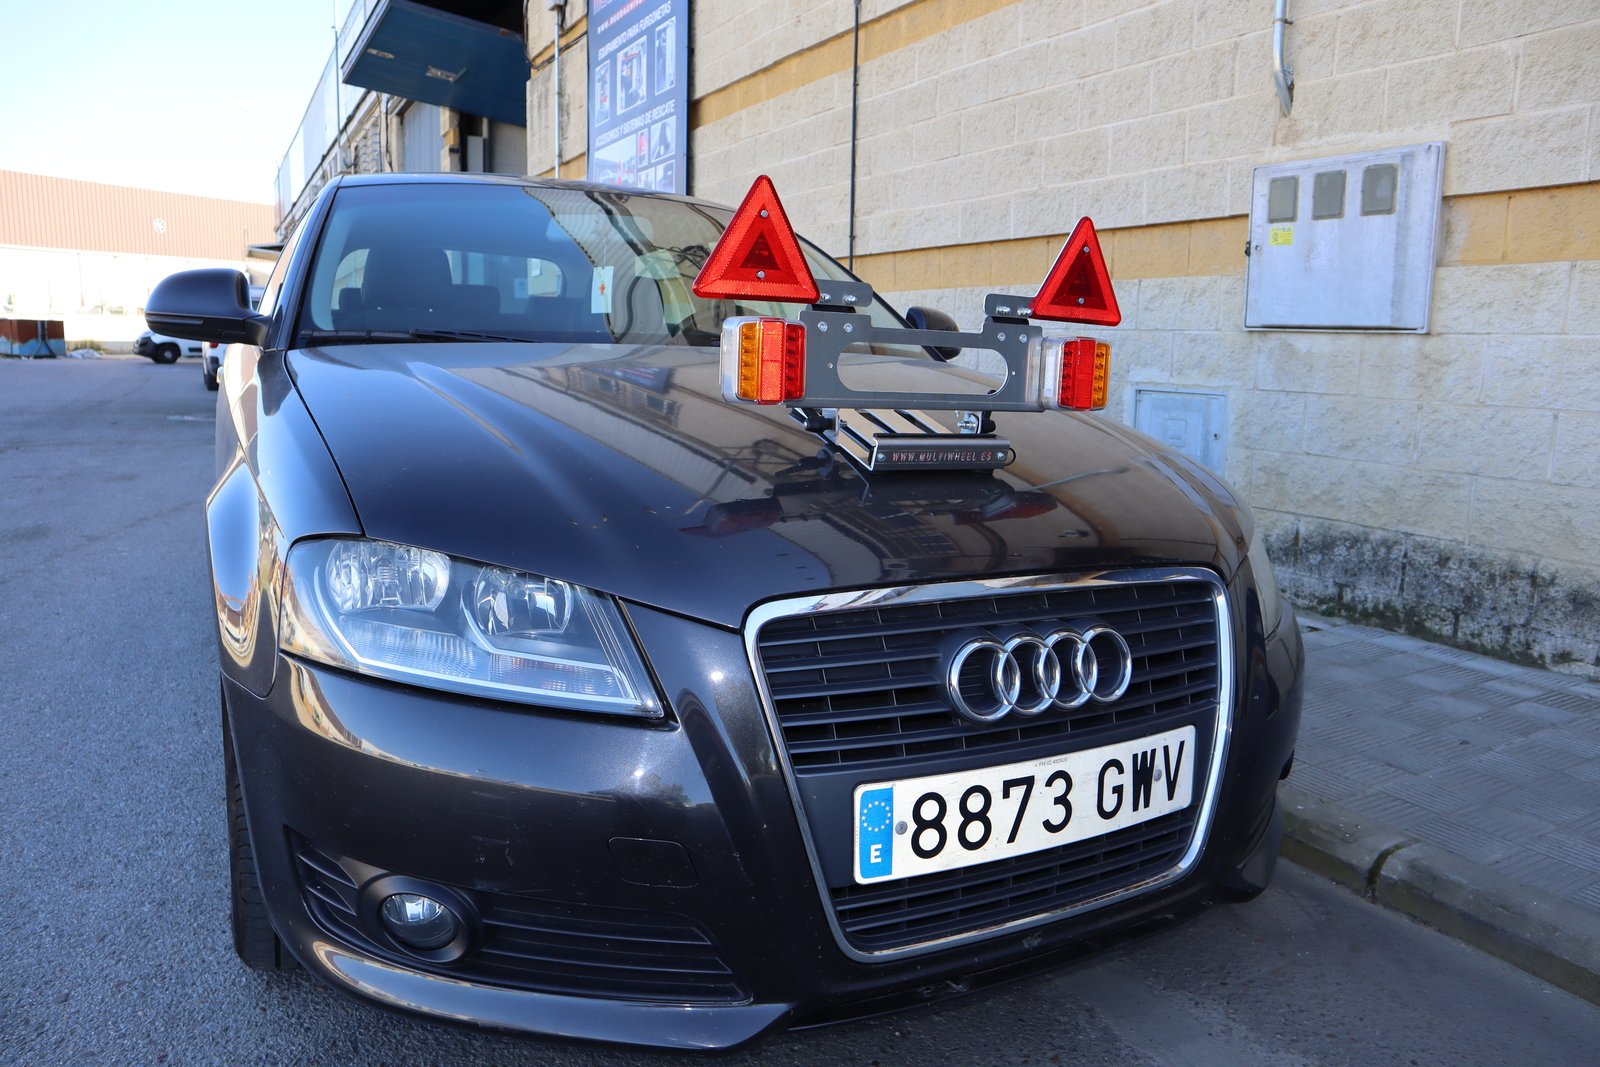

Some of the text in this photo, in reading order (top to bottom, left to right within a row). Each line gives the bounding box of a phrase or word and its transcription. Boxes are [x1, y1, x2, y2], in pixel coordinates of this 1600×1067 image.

[640, 0, 672, 31] FURGONETAS
[644, 110, 652, 124] DE
[652, 99, 676, 121] RESCATE
[910, 740, 1185, 859] 8873 GWV
[870, 843, 882, 864] E
